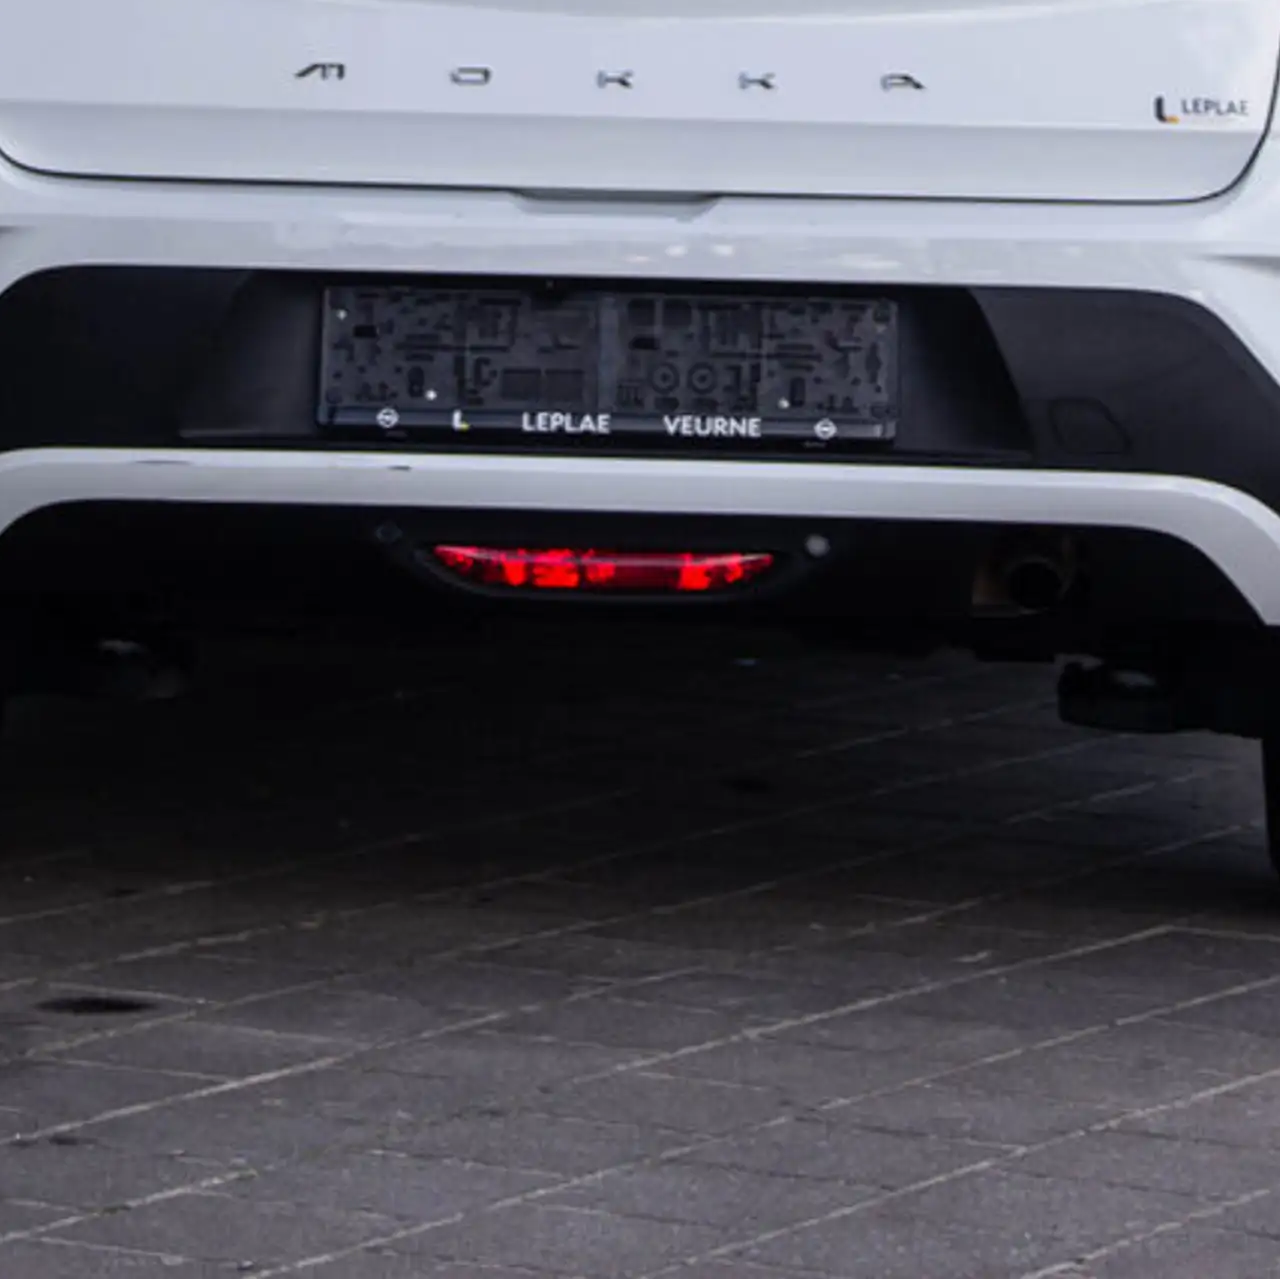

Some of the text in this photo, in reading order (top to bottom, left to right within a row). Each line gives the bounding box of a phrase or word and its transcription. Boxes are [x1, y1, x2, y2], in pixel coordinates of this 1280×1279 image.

[294, 61, 926, 90] MOKKA
[1181, 97, 1250, 117] LEPLAE
[521, 411, 612, 434] LEPLAE
[662, 414, 763, 438] VEURNE
